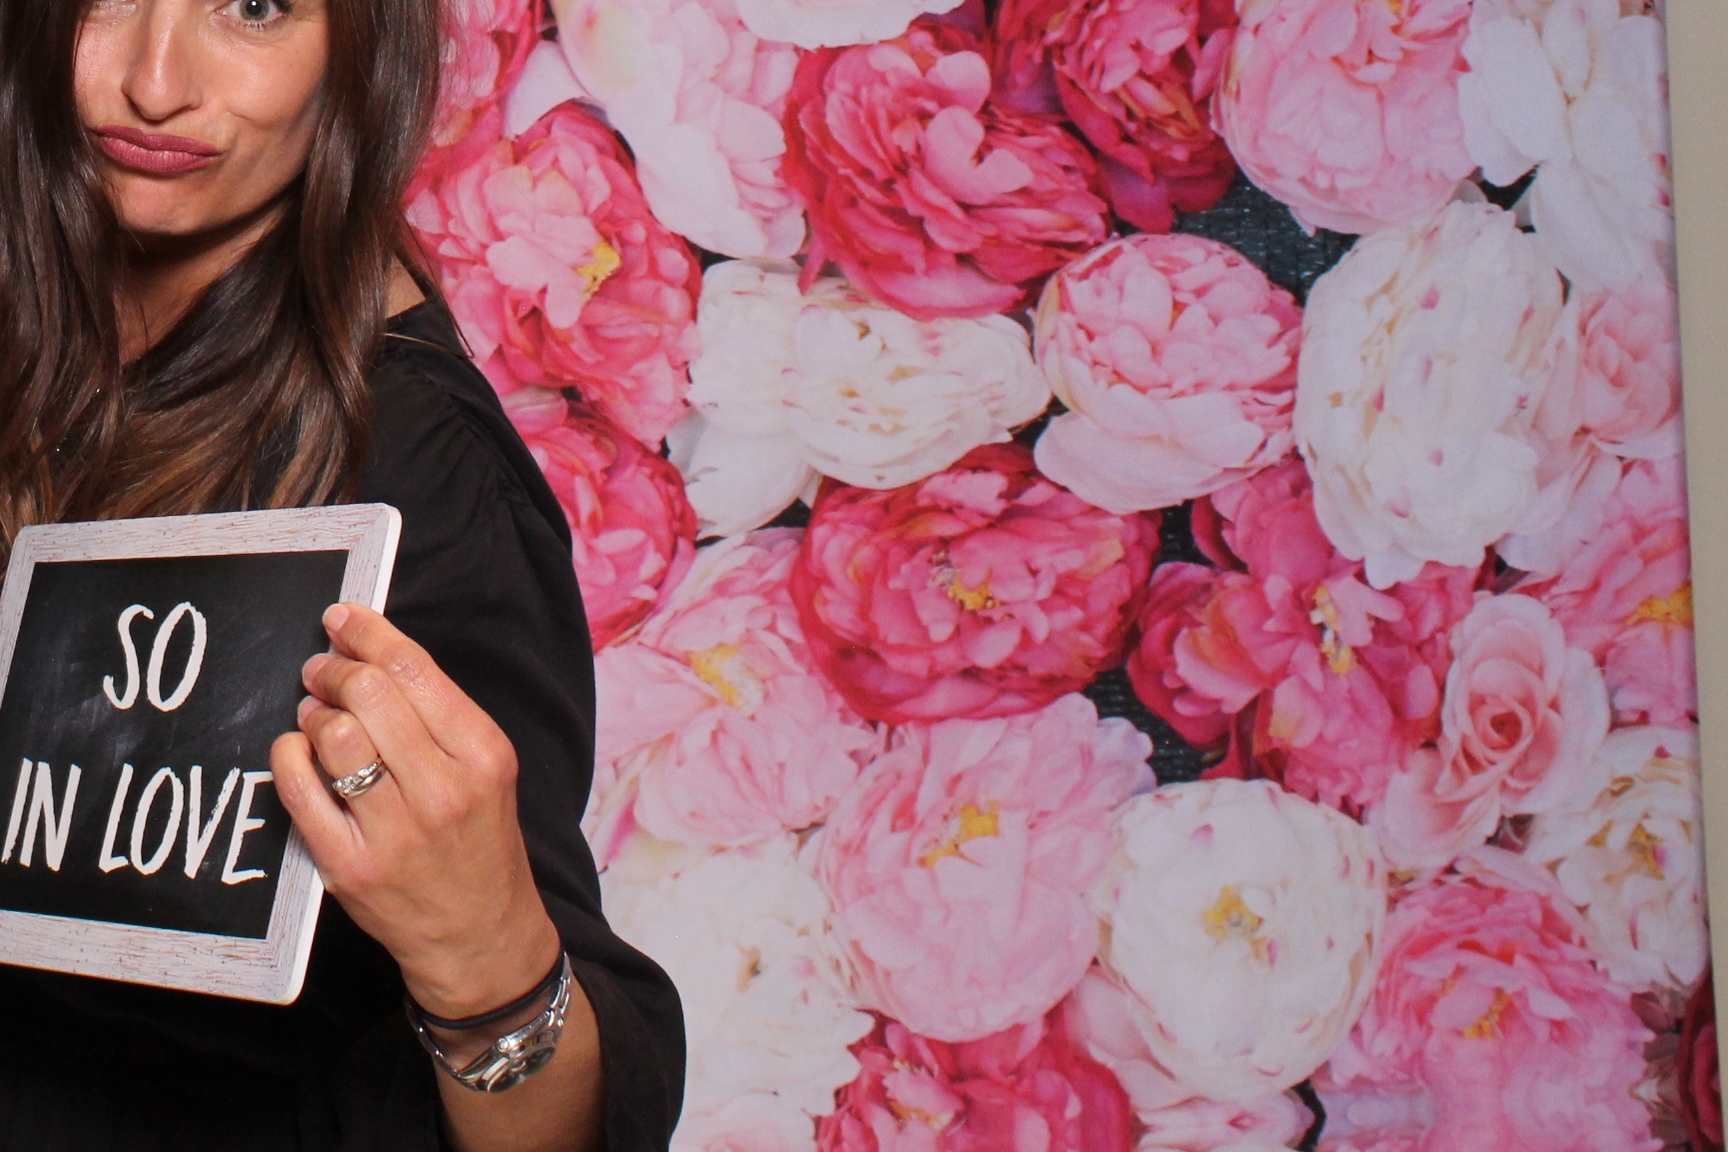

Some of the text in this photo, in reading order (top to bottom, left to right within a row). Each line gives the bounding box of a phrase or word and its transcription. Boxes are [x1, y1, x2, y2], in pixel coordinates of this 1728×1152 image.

[103, 601, 207, 712] SO
[1, 757, 274, 885] IN LOVE
